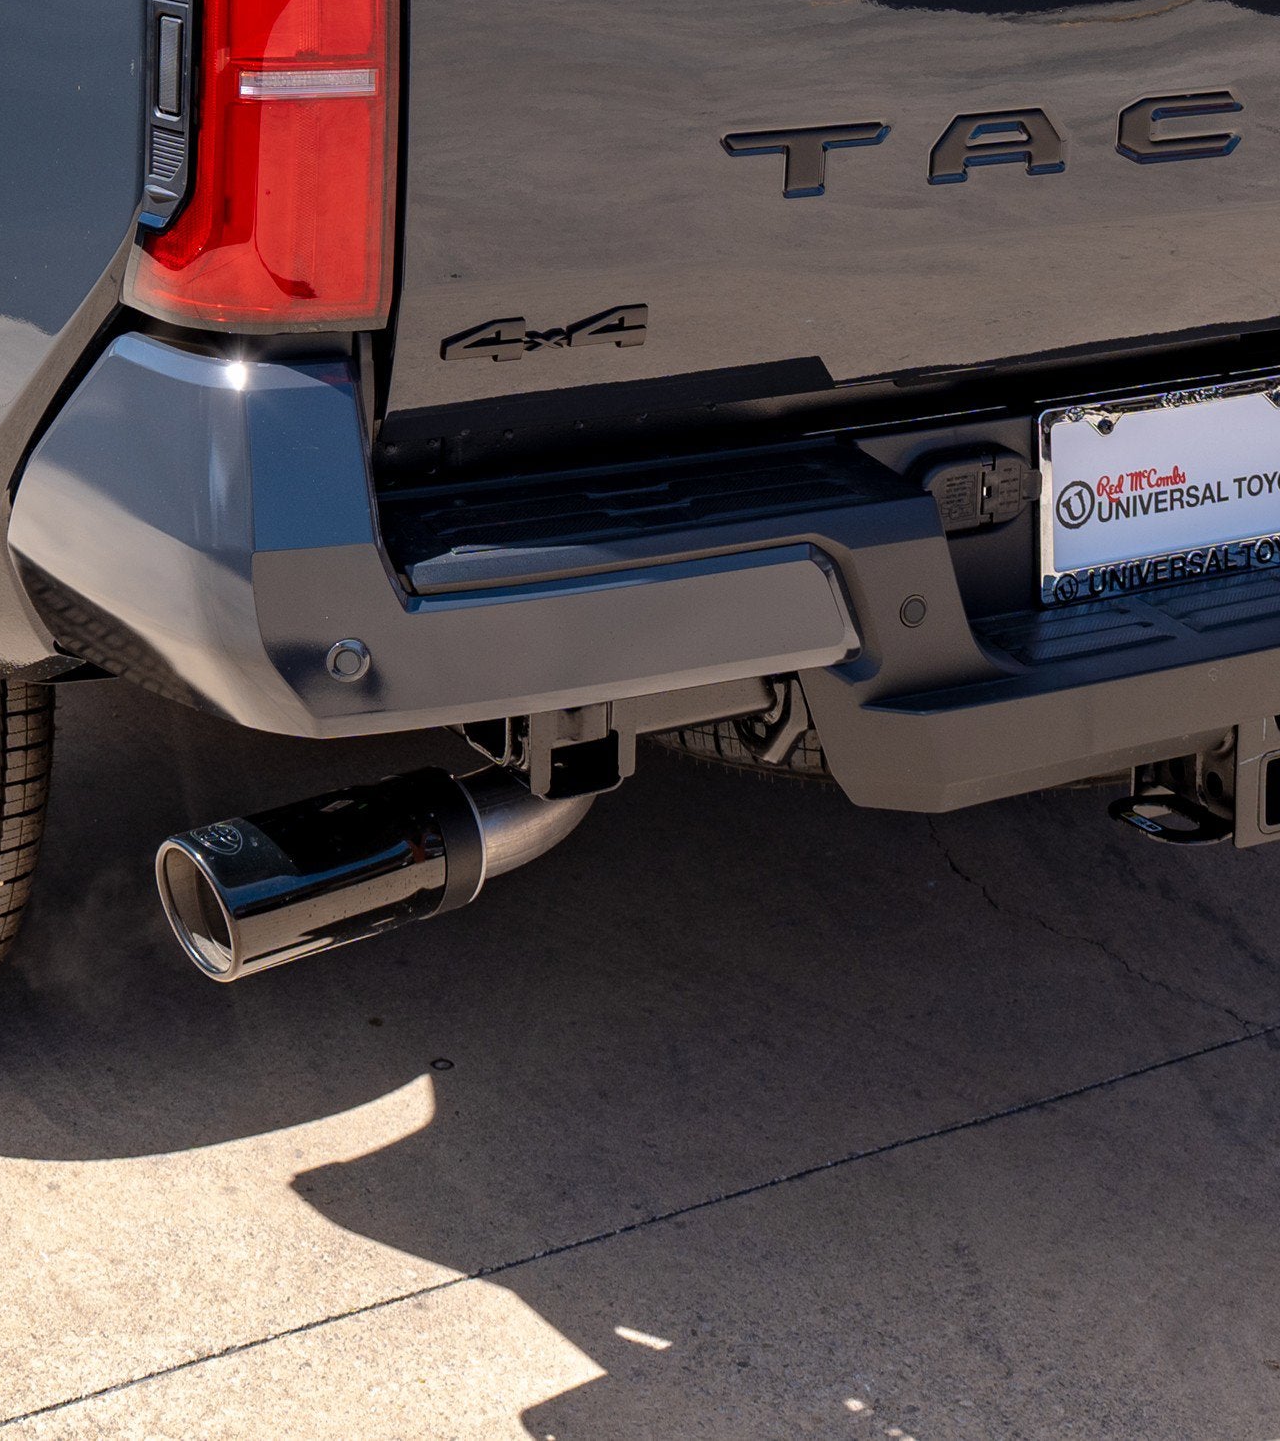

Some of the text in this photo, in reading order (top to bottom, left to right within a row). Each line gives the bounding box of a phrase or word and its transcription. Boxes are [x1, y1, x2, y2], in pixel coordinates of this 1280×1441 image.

[1096, 465, 1187, 504] Red McCombs
[1097, 480, 1229, 524] UNIVERSAL
[1087, 545, 1238, 596] UNIVERSAL
